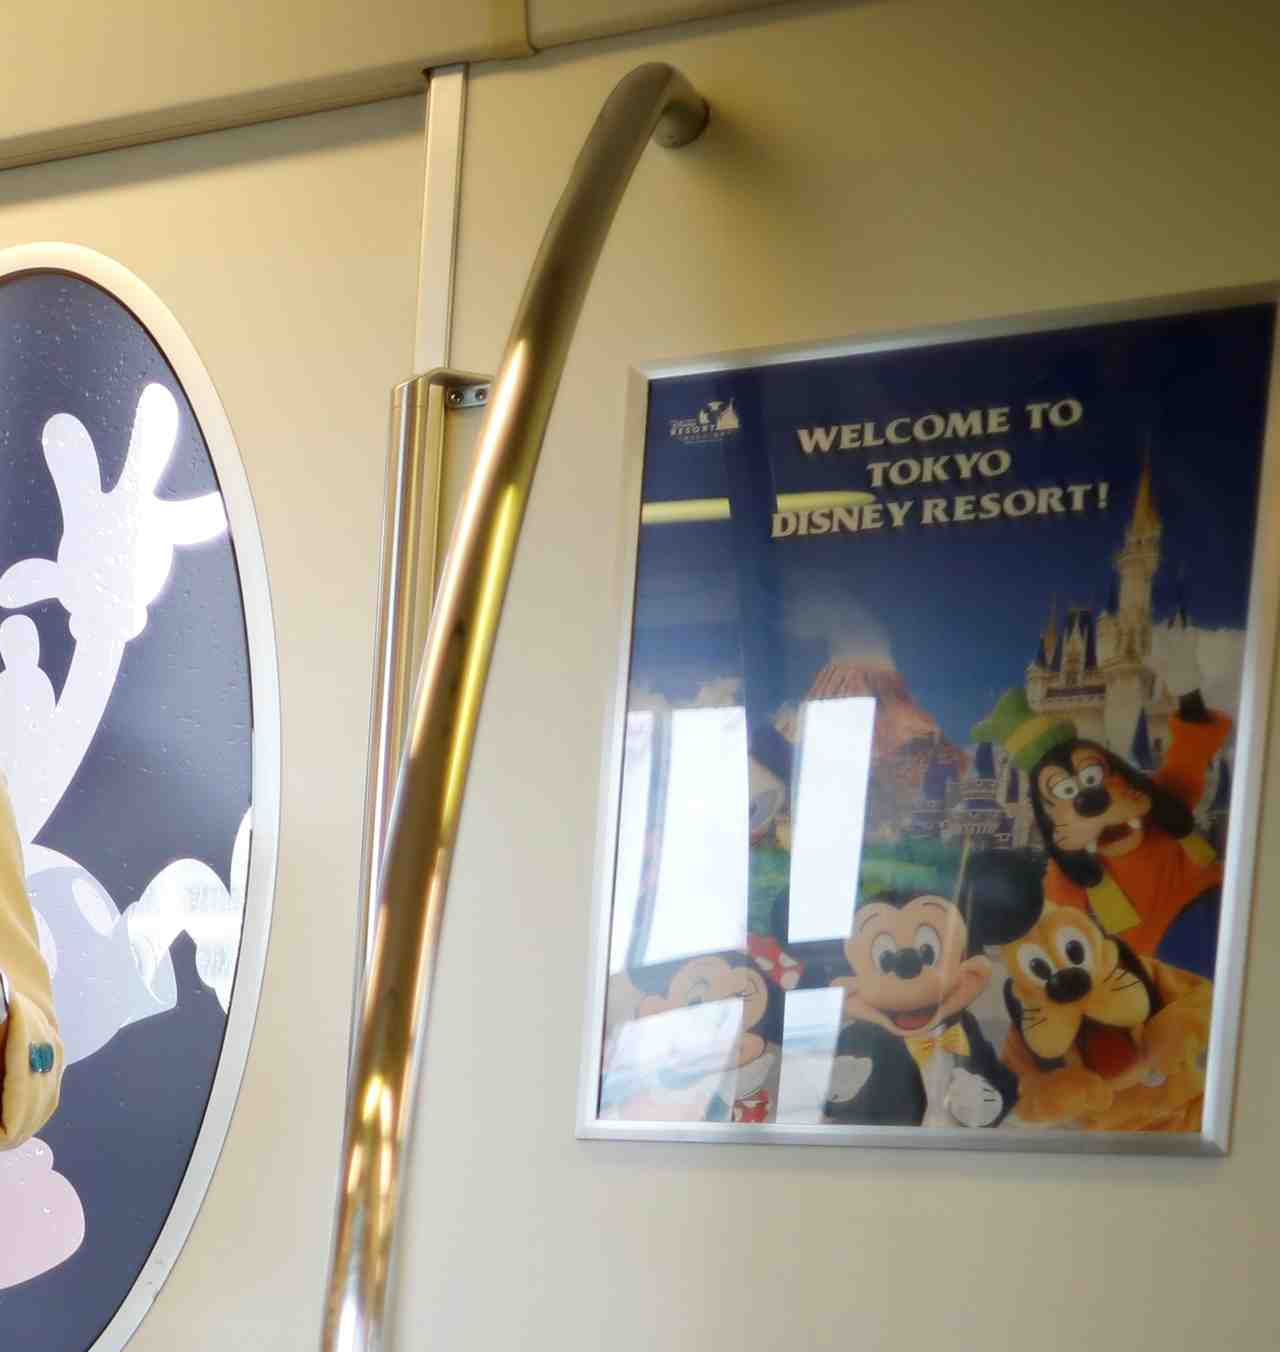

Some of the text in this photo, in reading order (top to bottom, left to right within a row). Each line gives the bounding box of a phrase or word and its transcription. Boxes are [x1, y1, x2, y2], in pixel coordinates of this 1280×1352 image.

[796, 398, 1083, 454] WELCOME TO
[867, 449, 1012, 488] TOKYO
[770, 482, 1110, 538] DISNEY RESORT!
